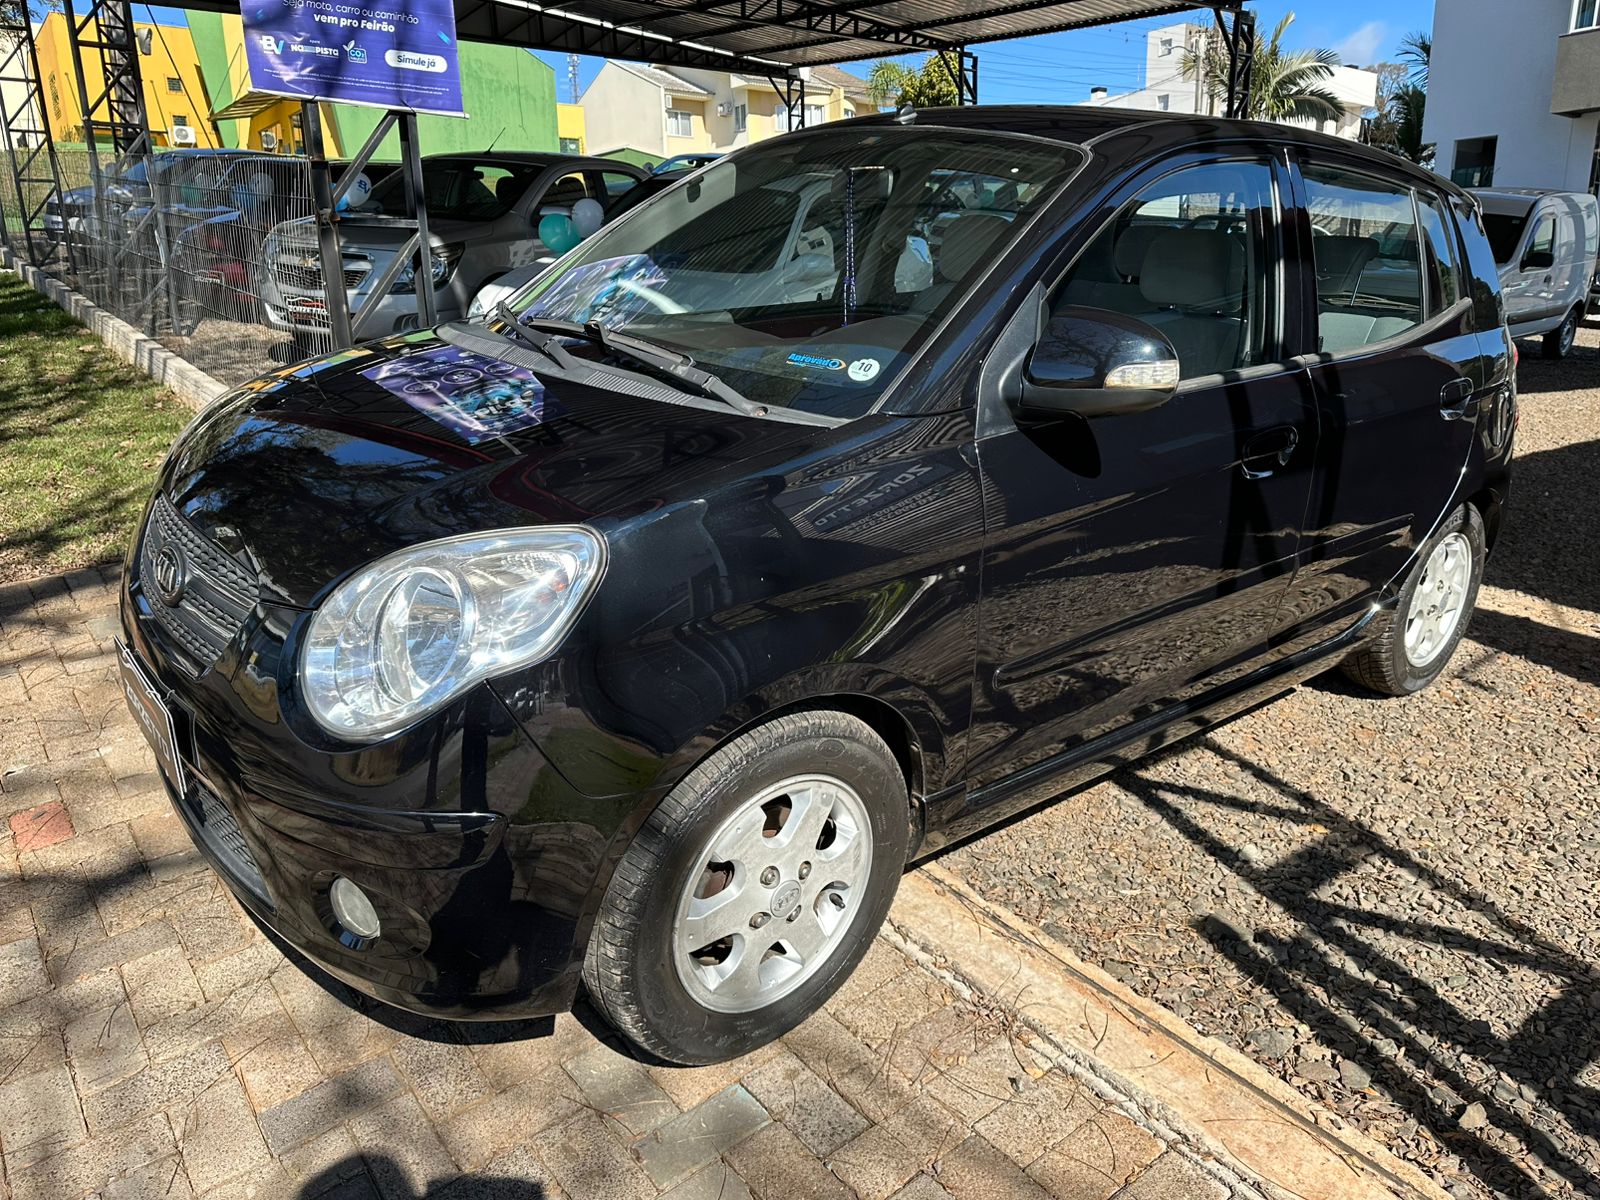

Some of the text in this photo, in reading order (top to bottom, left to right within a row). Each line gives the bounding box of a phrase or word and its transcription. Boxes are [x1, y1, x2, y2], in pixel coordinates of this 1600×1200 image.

[306, 1, 334, 13] moto,
[335, 5, 361, 15] carro
[362, 8, 374, 17] ou
[374, 10, 419, 25] caminhão
[313, 13, 395, 33] vem pro Feirão
[396, 54, 436, 69] Simule já
[858, 362, 873, 373] 10
